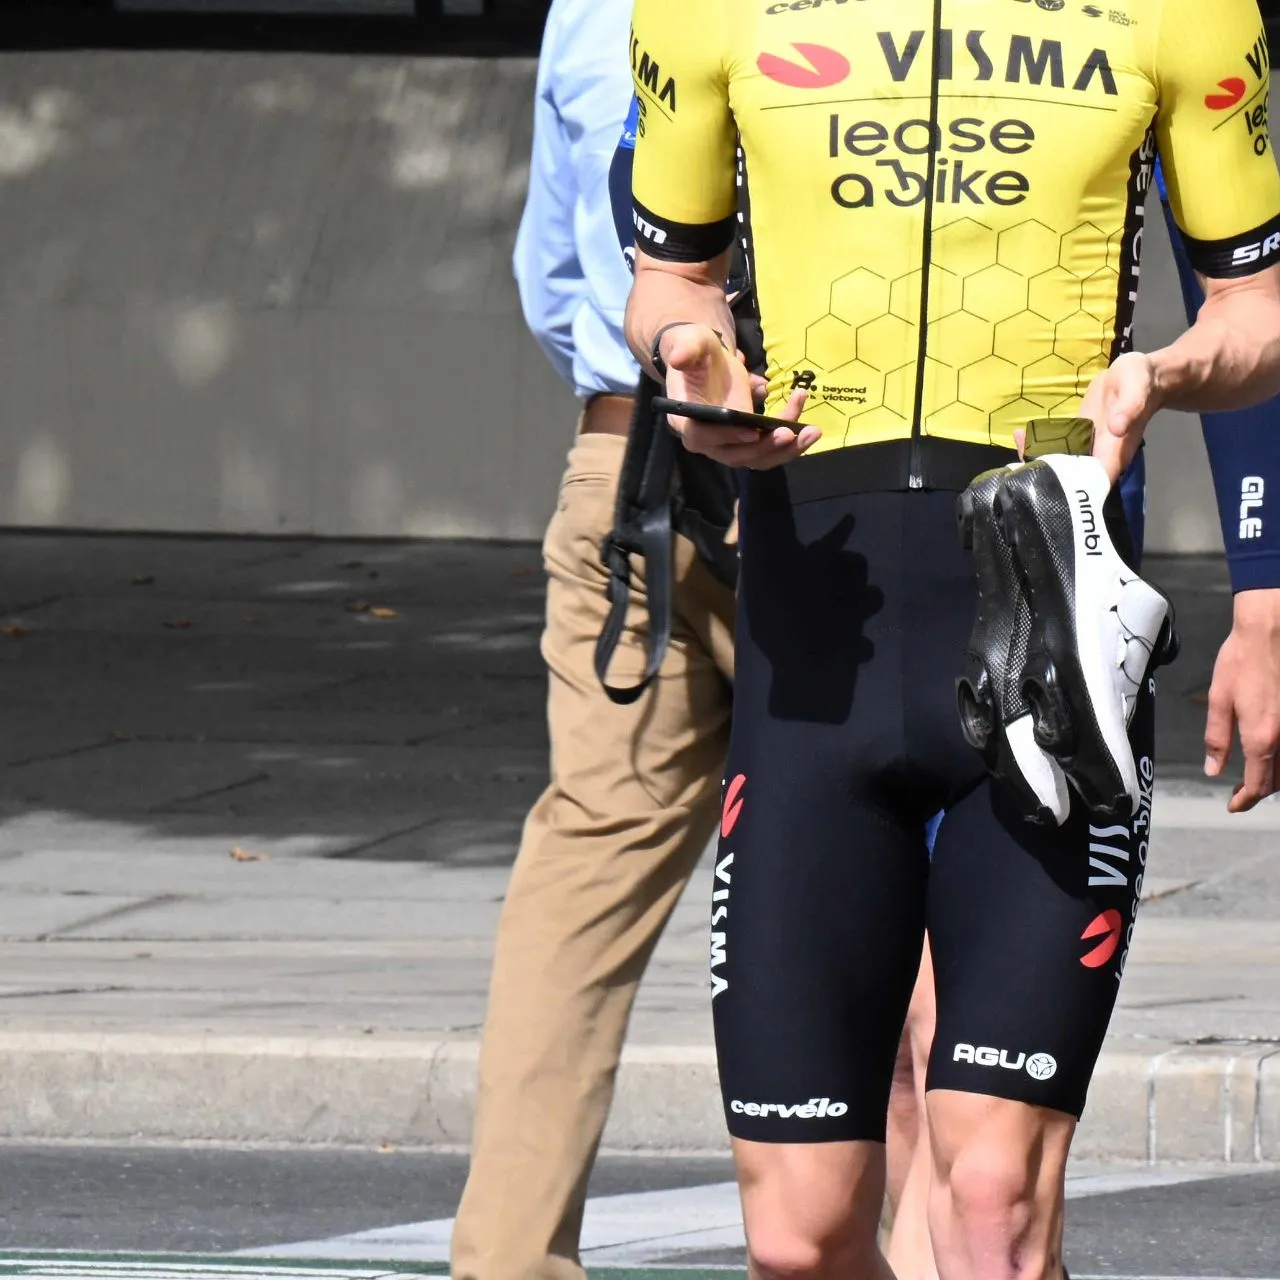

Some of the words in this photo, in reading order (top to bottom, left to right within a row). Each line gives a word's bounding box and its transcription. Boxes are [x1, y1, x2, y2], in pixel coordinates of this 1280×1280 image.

[876, 28, 1119, 96] VISMA
[829, 114, 1036, 158] lease
[1074, 489, 1103, 557] nimbl
[953, 1042, 1027, 1070] AGU
[730, 1097, 849, 1119] cervélo
